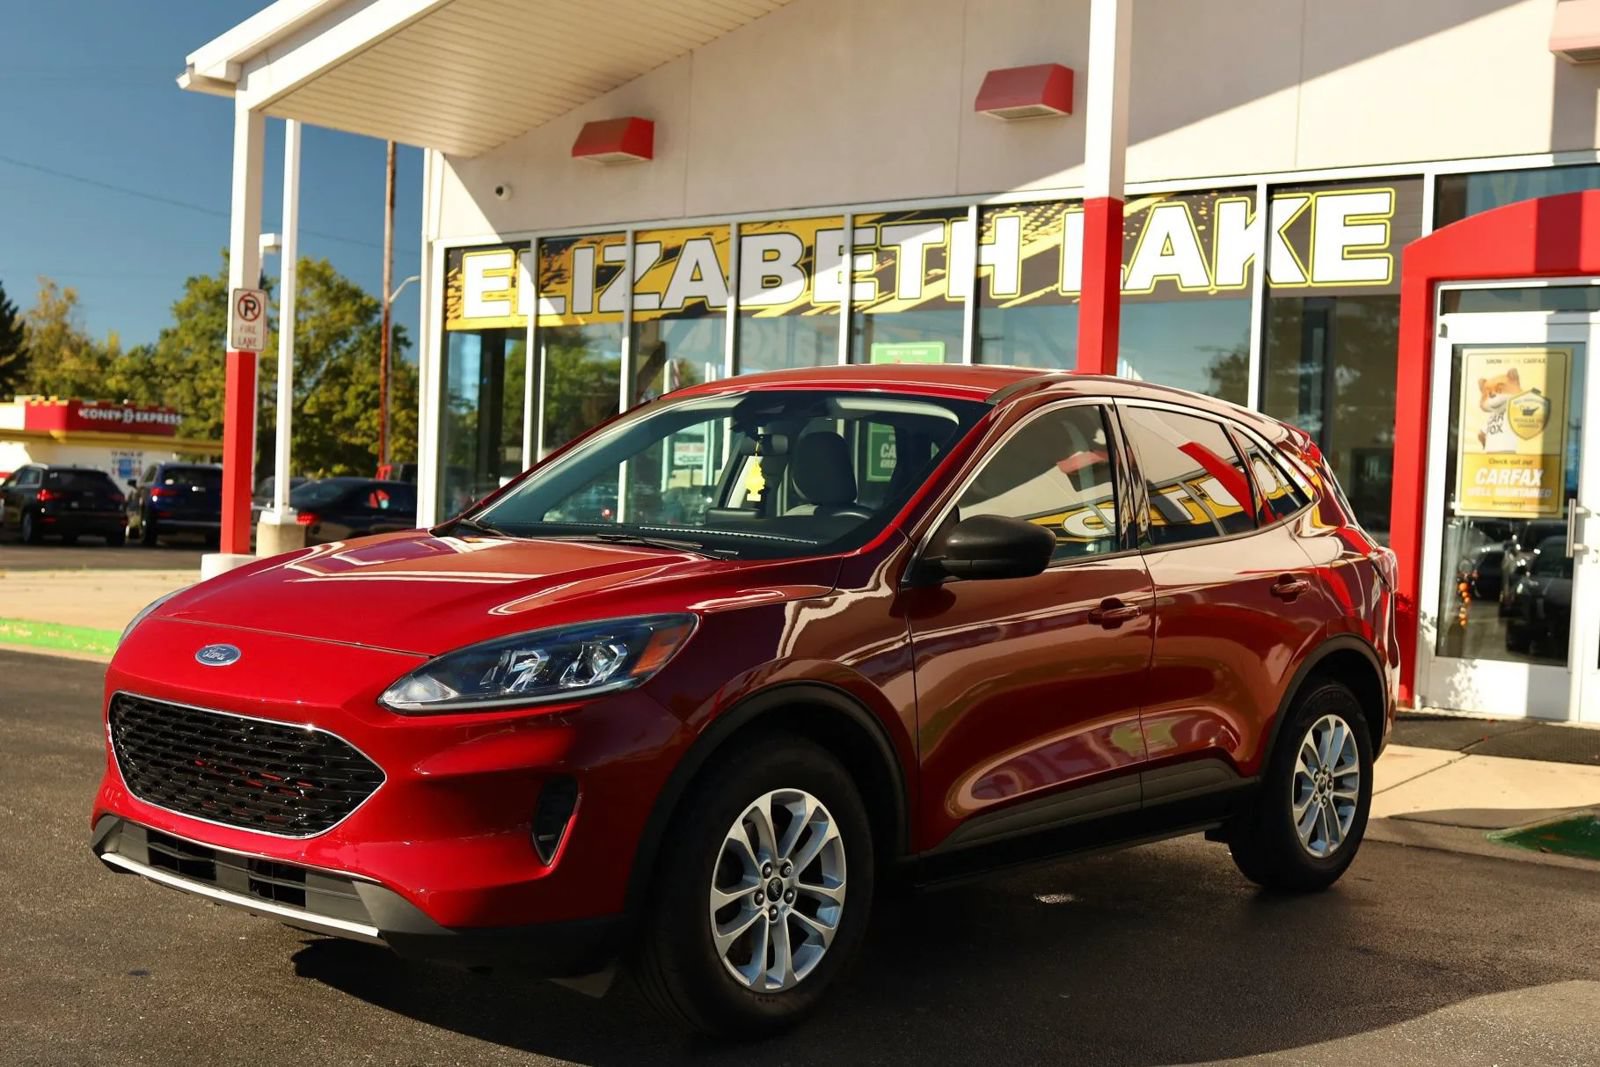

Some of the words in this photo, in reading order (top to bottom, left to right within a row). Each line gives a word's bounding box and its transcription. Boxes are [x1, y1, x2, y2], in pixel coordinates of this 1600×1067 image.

[461, 212, 1022, 320] ELIZABETH
[79, 408, 122, 420] CONEY
[135, 411, 182, 425] EXPRESS
[1476, 467, 1543, 486] CARFAX
